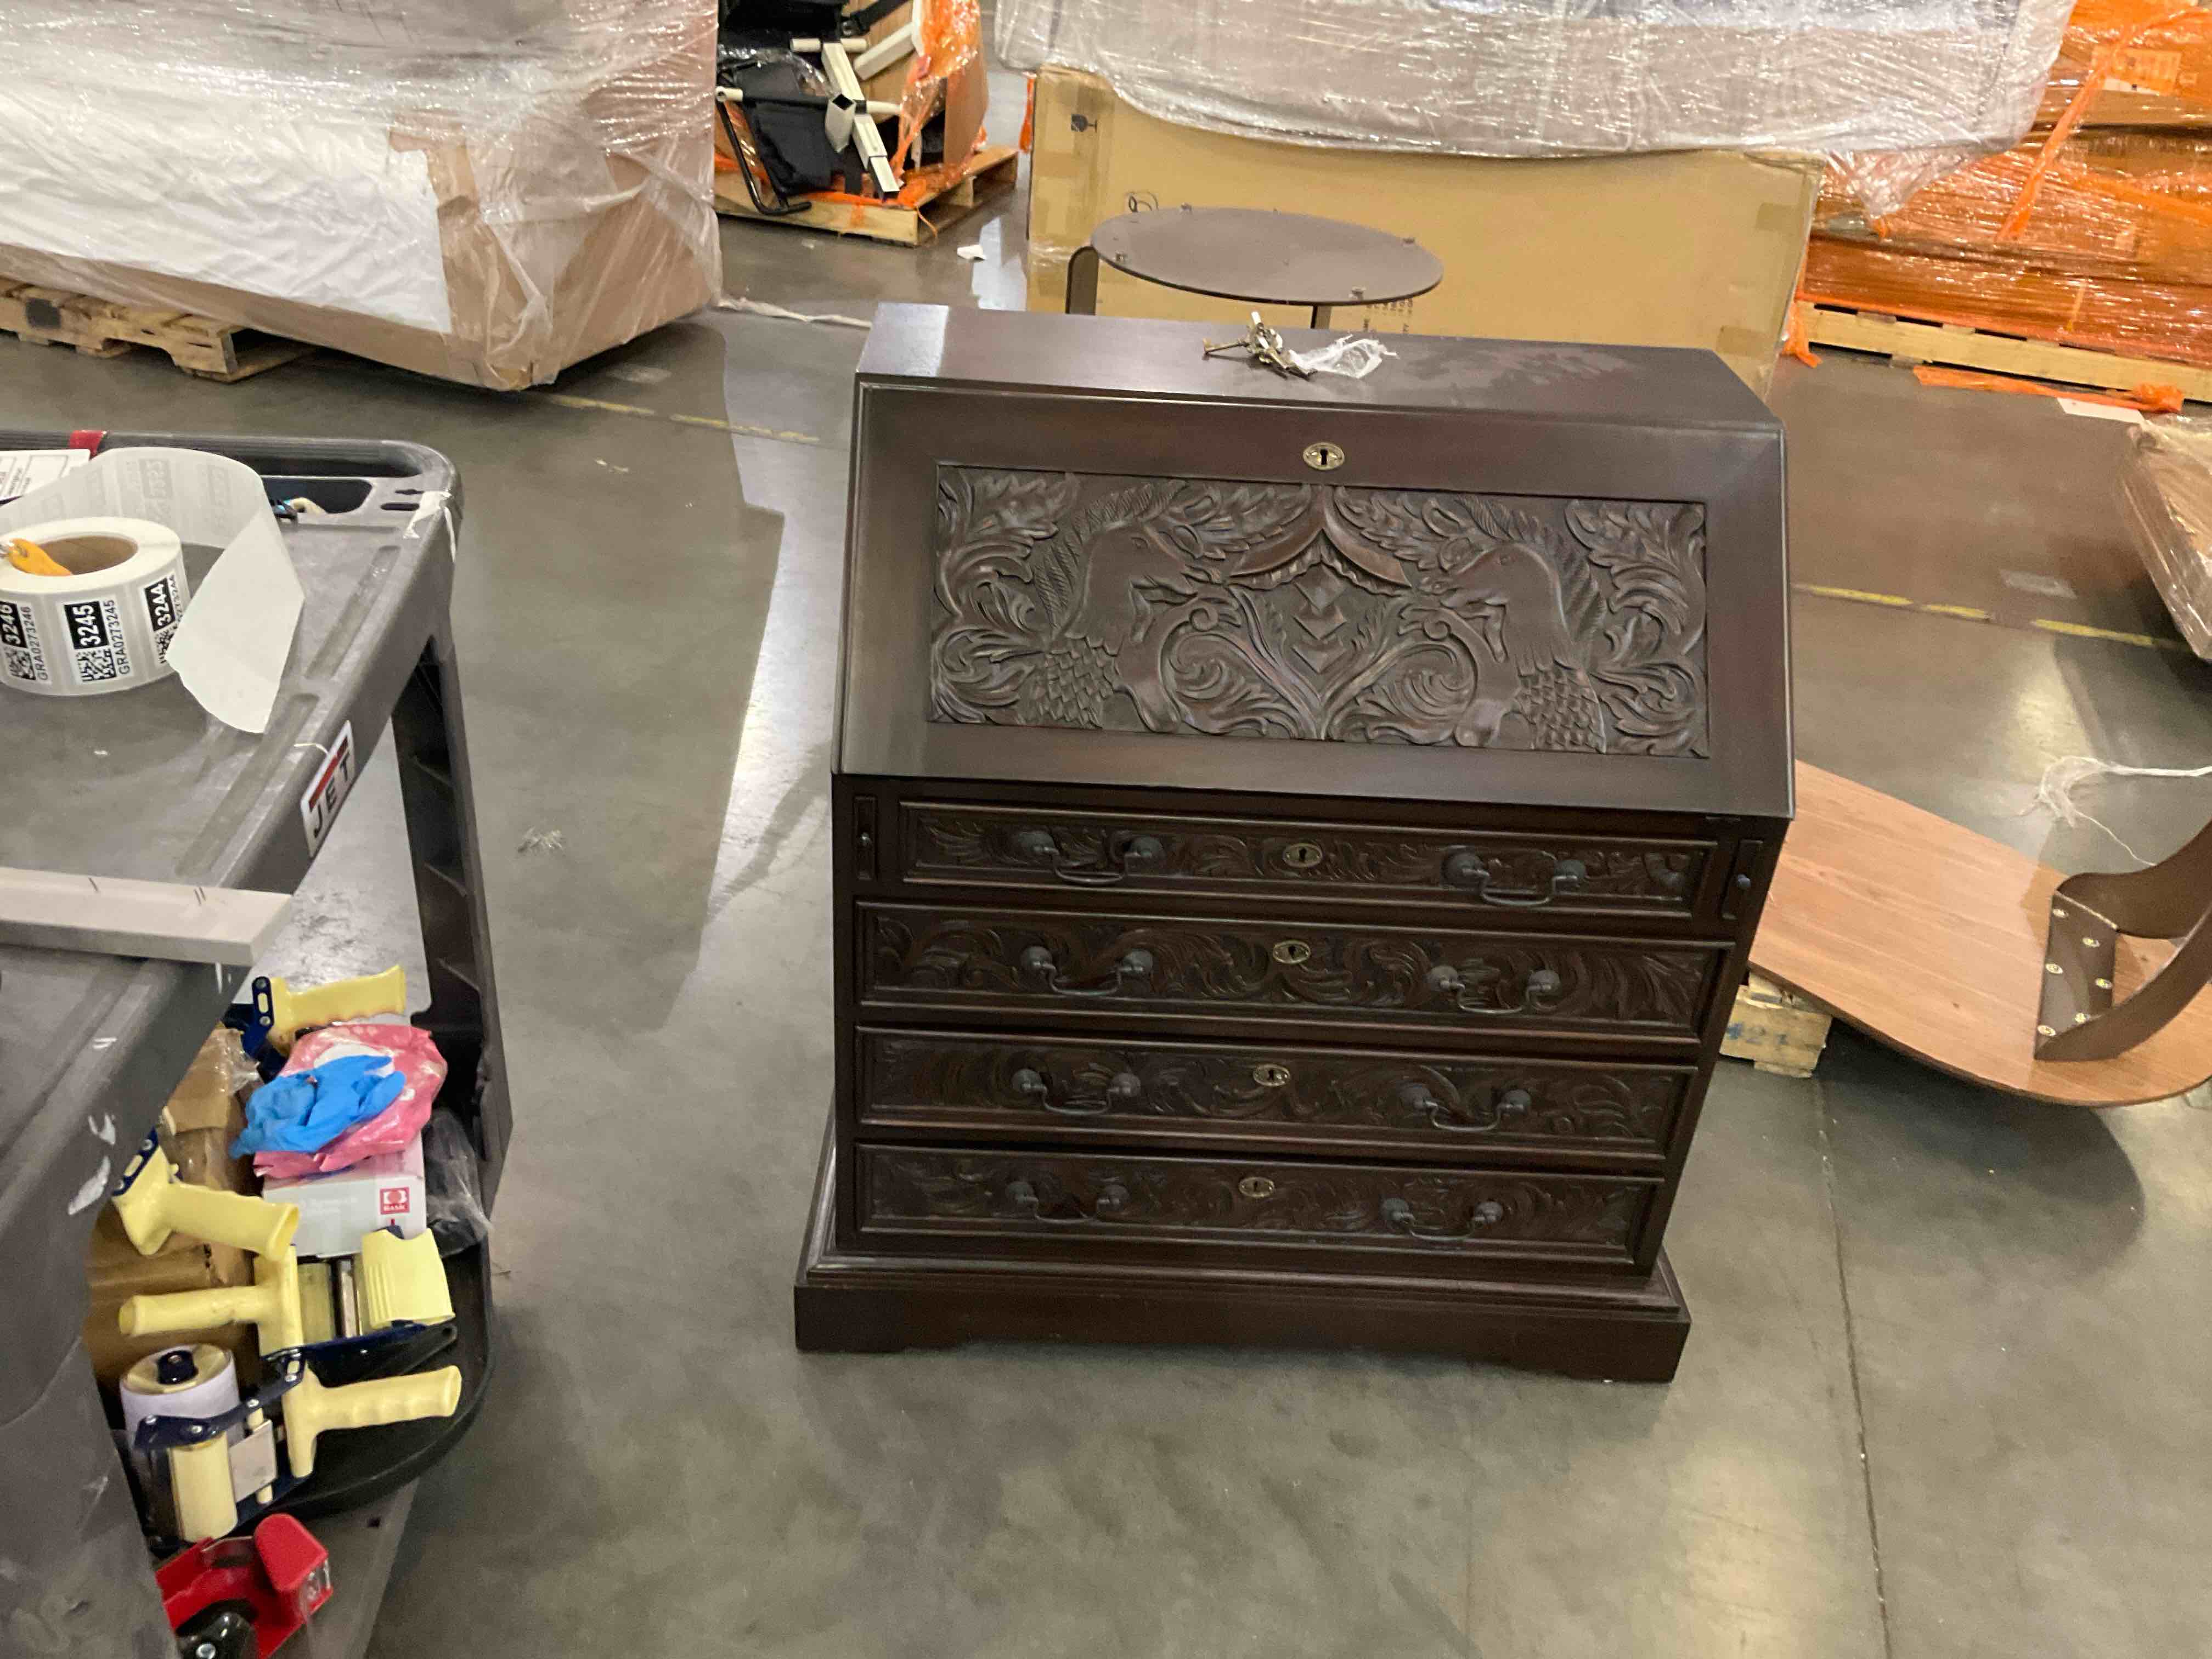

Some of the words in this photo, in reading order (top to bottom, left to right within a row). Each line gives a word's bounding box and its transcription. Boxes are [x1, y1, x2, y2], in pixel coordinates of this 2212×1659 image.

[72, 605, 101, 646] 3245
[150, 583, 172, 627] 3244
[103, 599, 131, 675] GRA0273245
[313, 751, 350, 839] JET
